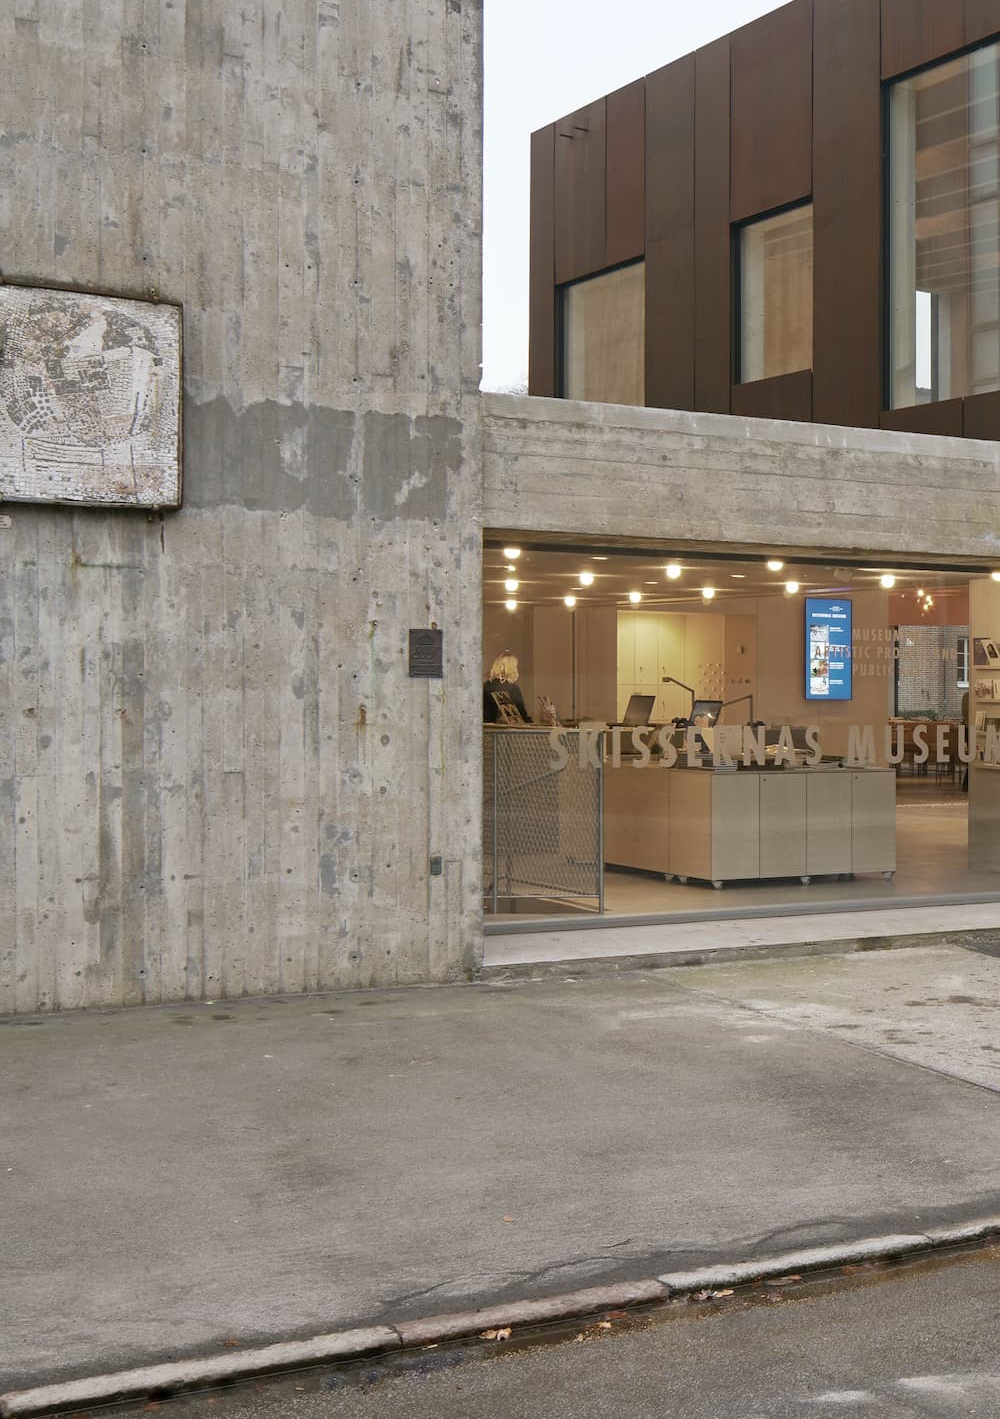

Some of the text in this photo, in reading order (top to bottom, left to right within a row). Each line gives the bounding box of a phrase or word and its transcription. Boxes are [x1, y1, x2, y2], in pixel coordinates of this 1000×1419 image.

[852, 628, 900, 642] MUSEUM
[814, 645, 871, 660] ARTISTIC
[852, 662, 895, 677] PUBLIC
[549, 723, 823, 771] SKISSERNAS
